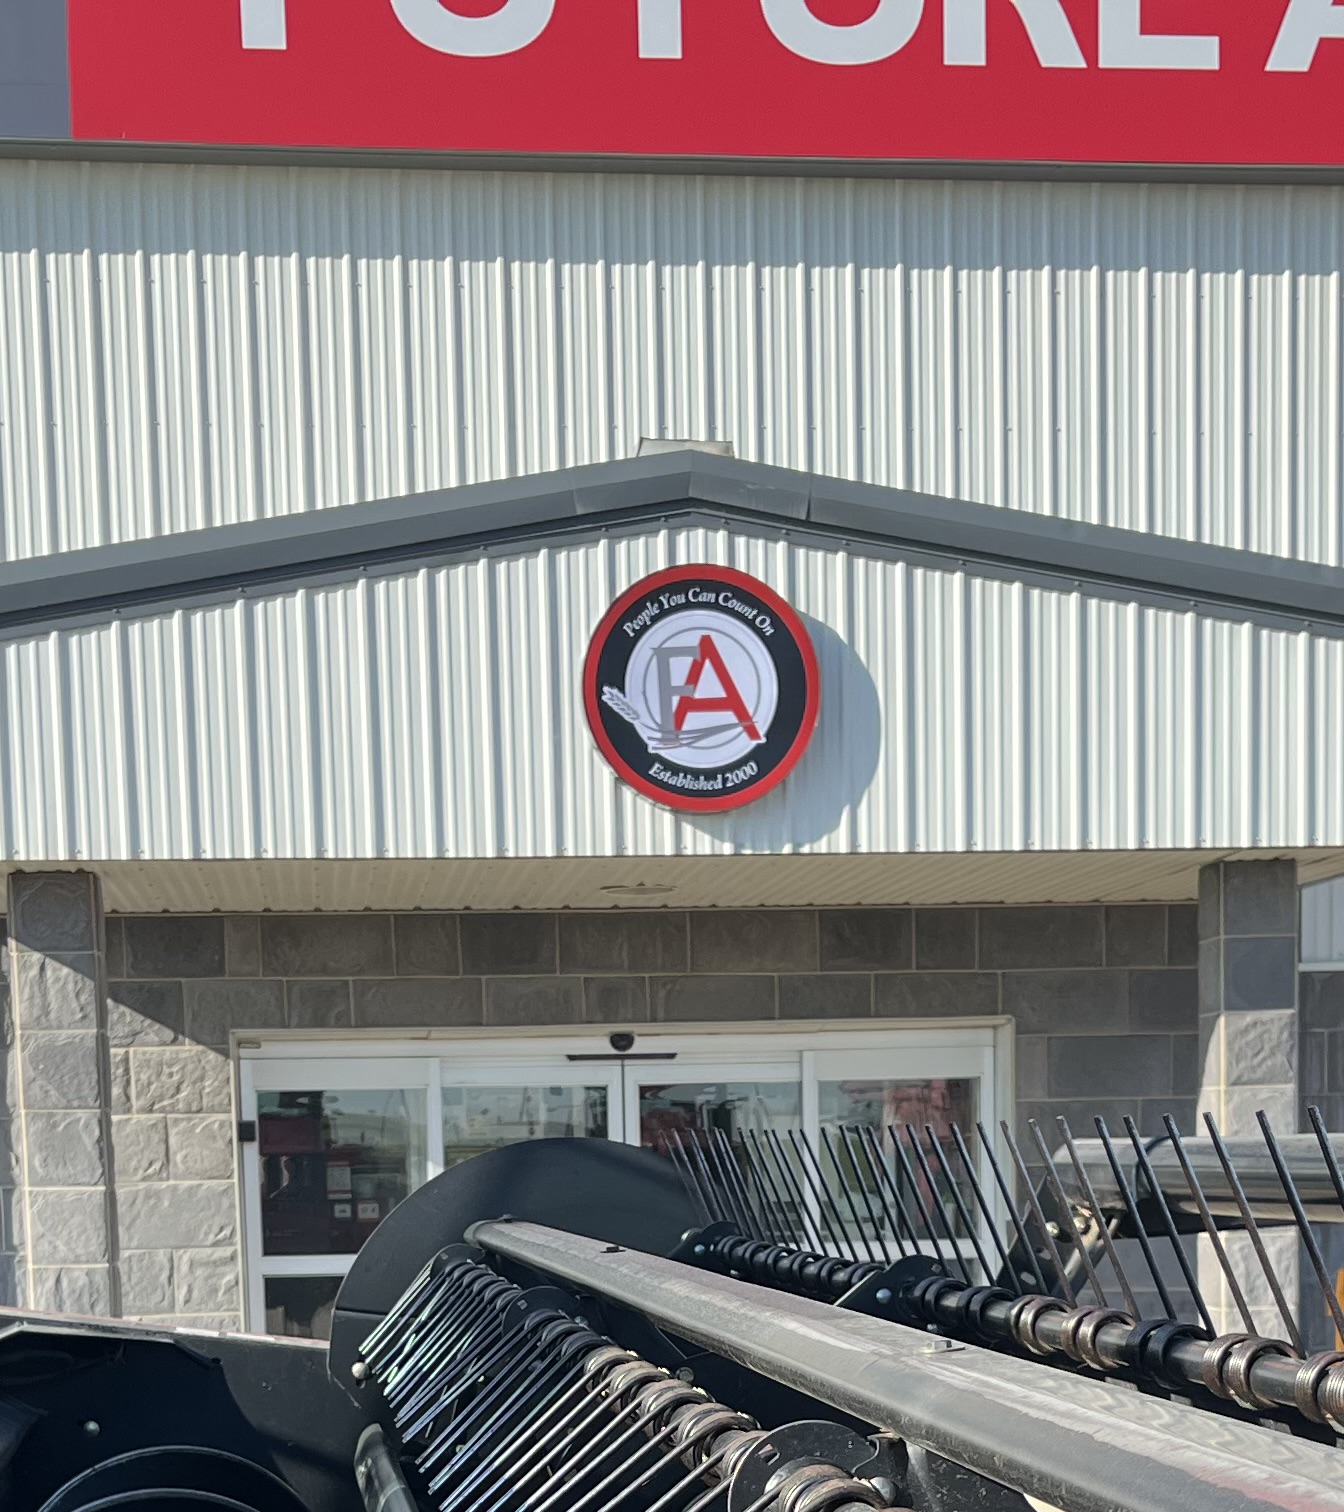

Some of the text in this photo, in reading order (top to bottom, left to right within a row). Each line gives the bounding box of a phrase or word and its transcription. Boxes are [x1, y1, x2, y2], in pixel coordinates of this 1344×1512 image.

[622, 587, 775, 637] People You Can Count On
[648, 760, 759, 790] Established 2000
